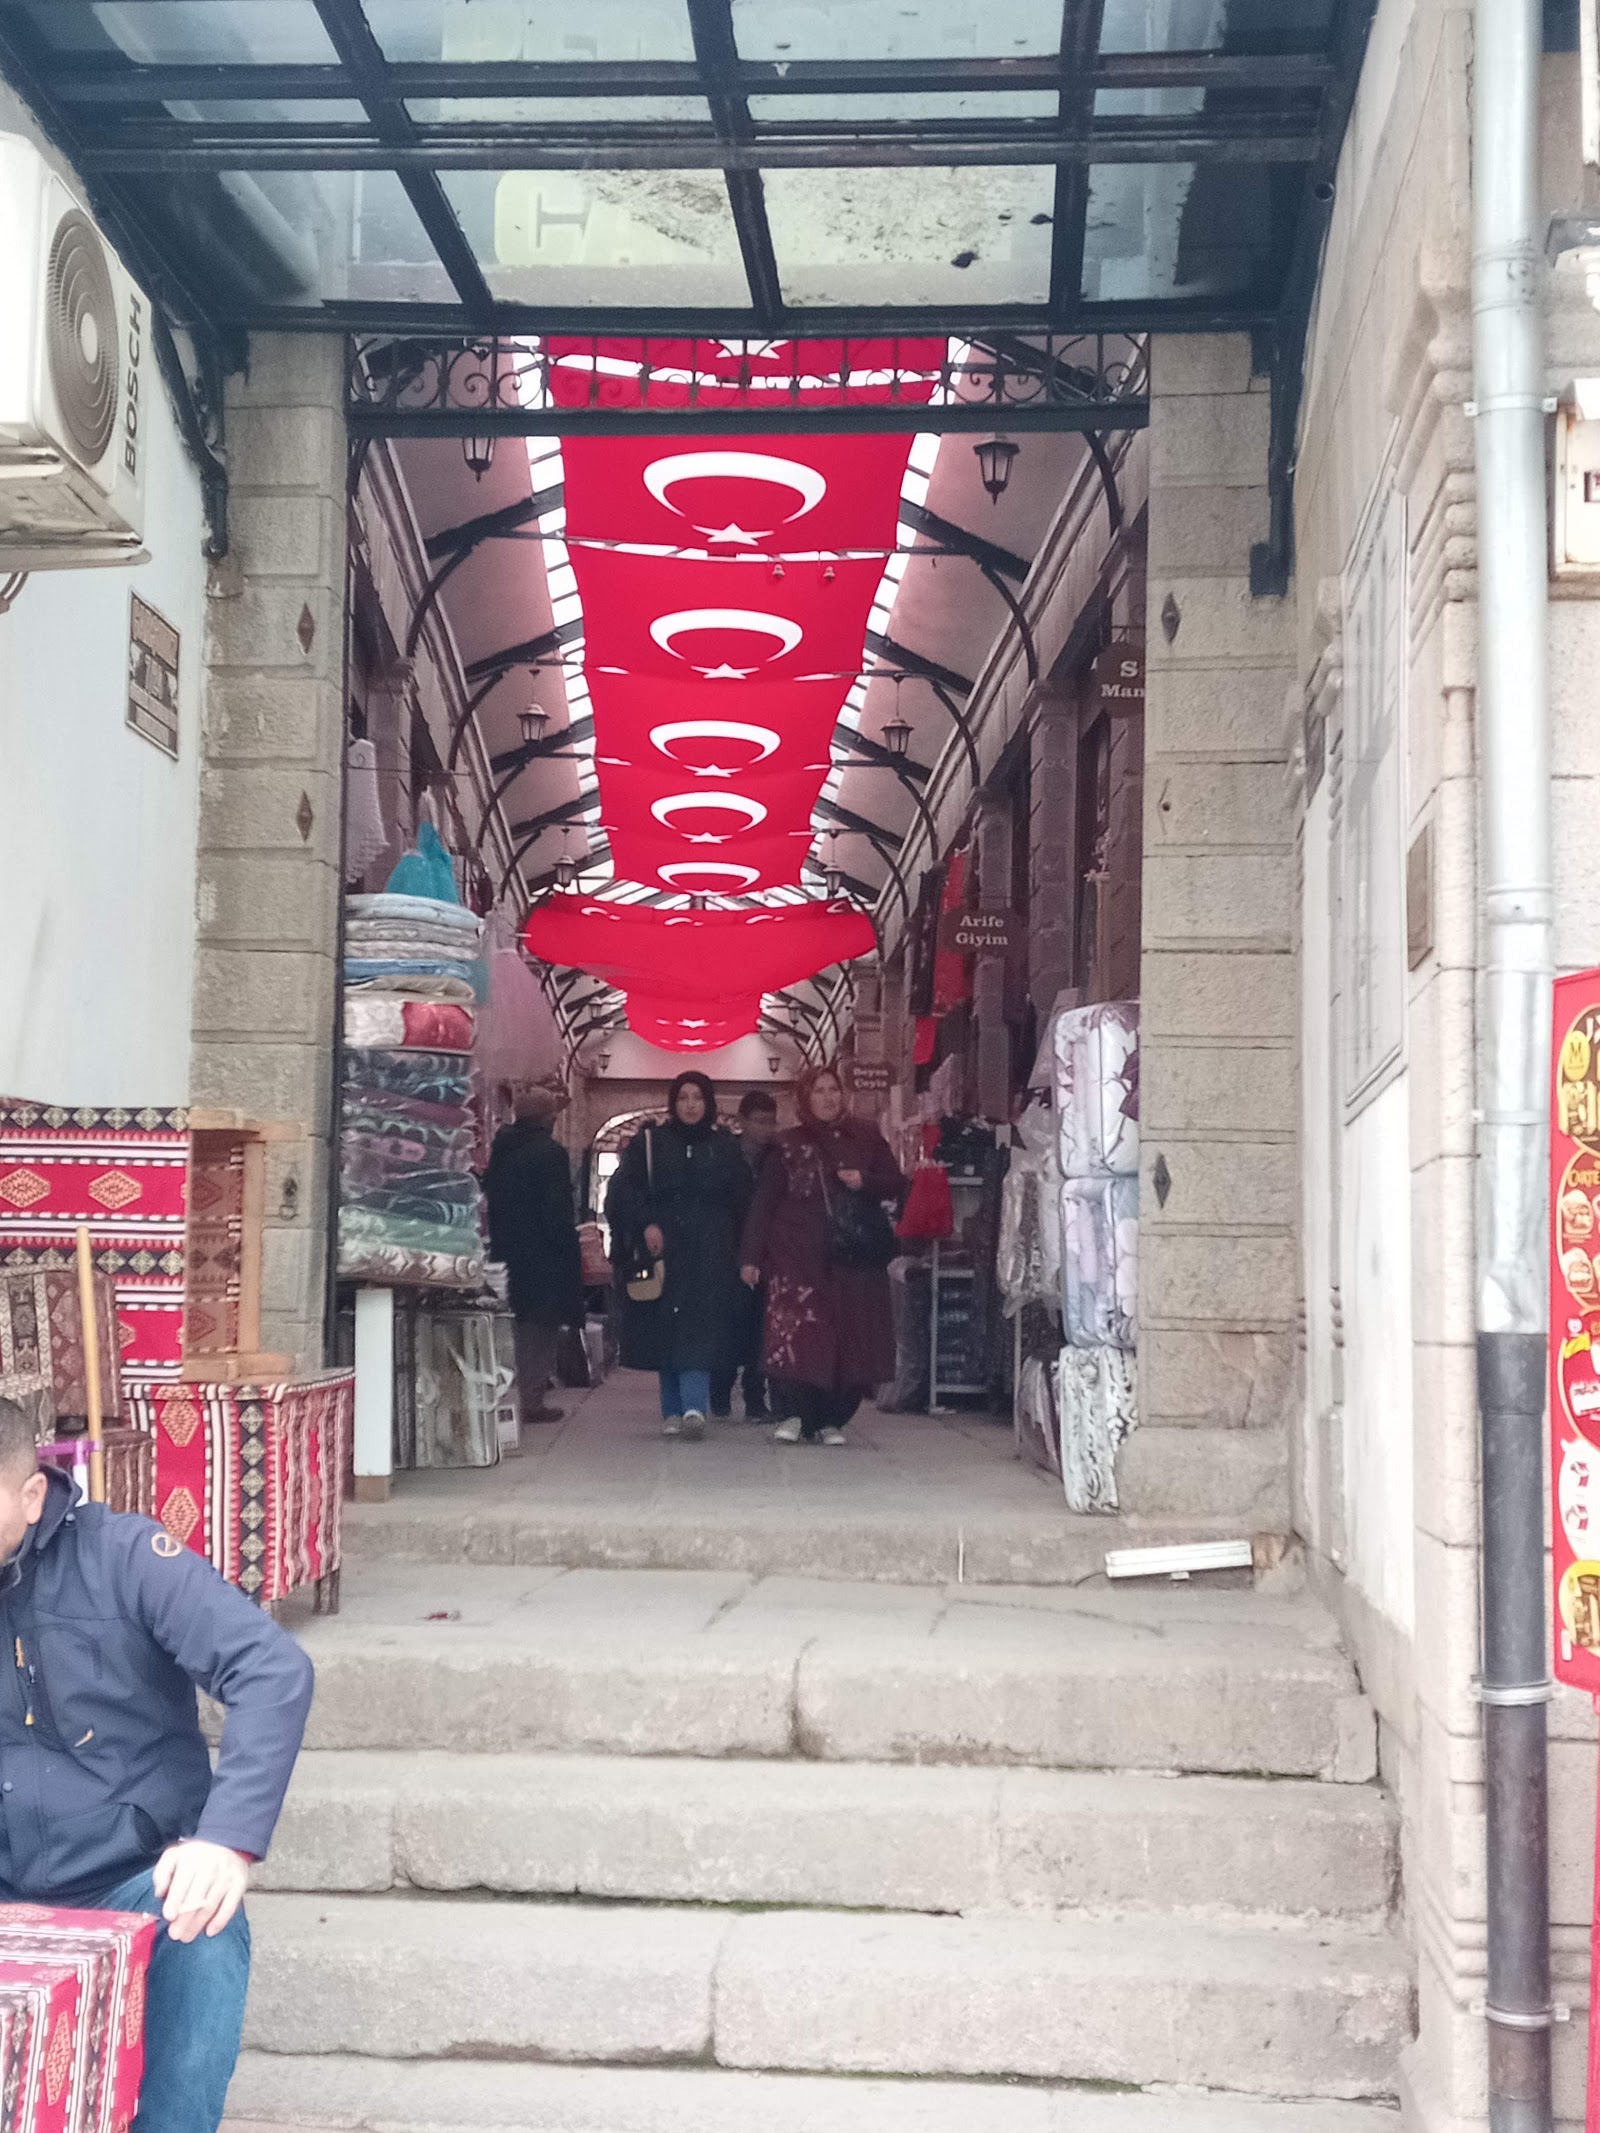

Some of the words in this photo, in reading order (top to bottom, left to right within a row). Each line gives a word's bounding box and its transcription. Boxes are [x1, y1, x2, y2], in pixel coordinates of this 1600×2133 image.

[124, 293, 142, 477] BOSCH
[960, 915, 1004, 928] Arife
[955, 932, 1008, 947] Giyim
